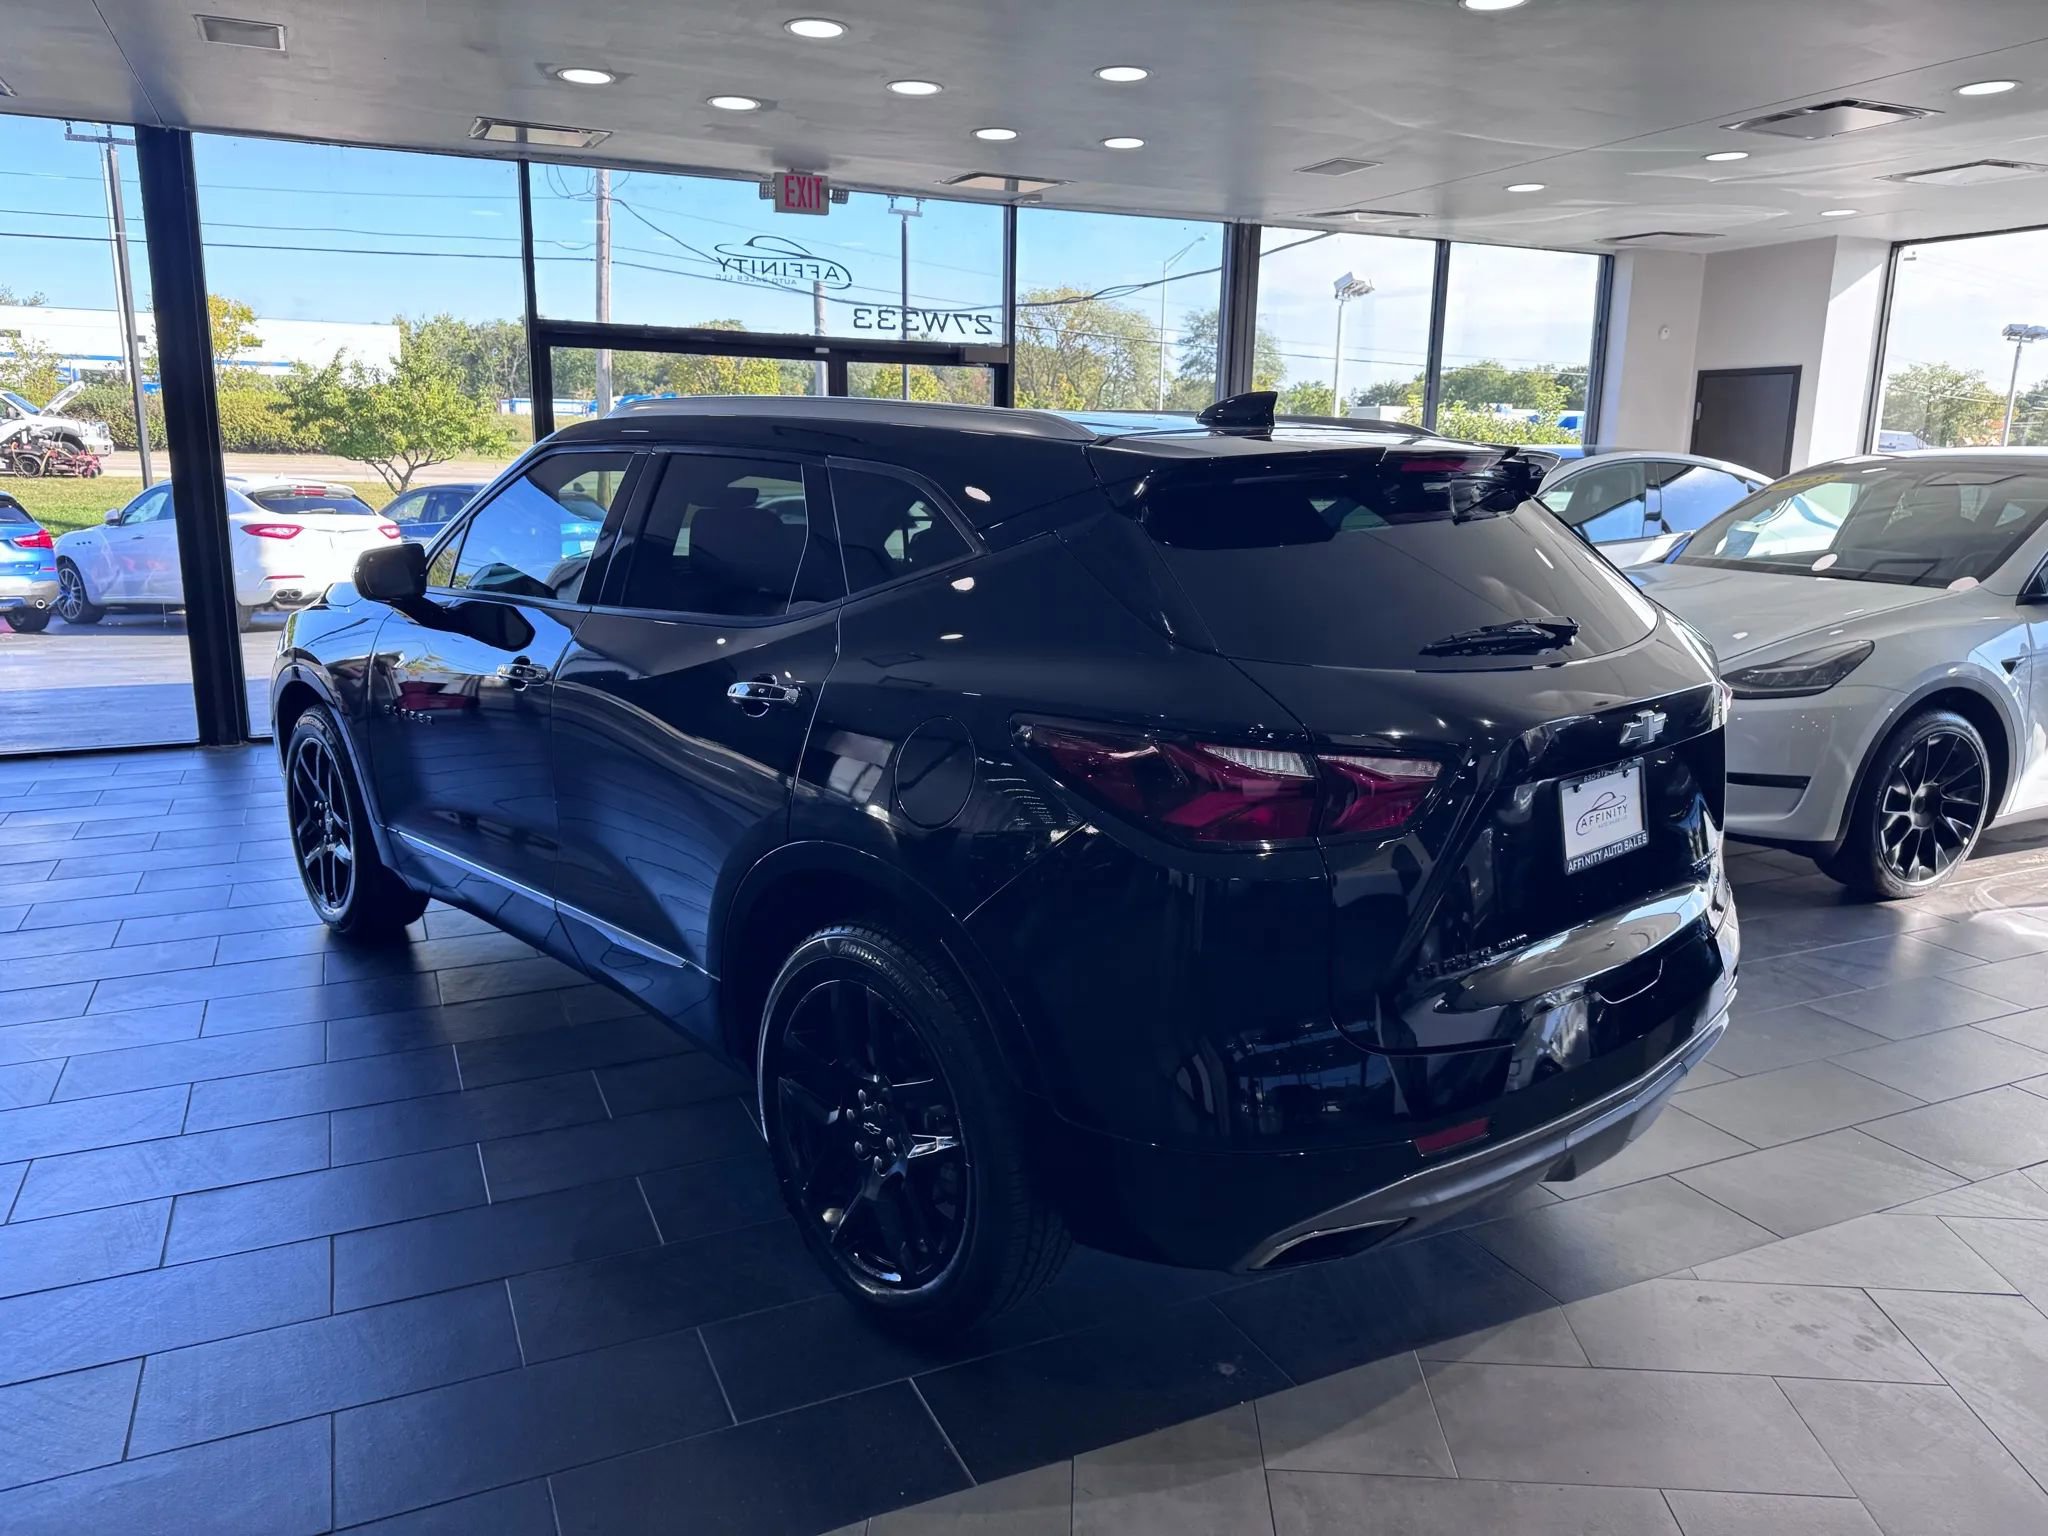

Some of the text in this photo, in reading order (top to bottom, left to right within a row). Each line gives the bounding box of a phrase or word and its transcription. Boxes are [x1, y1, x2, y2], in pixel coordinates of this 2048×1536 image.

[784, 175, 822, 208] EXIT
[1581, 804, 1628, 829] AFFINITY
[1567, 833, 1647, 873] AFFINITY AUTO SALES
